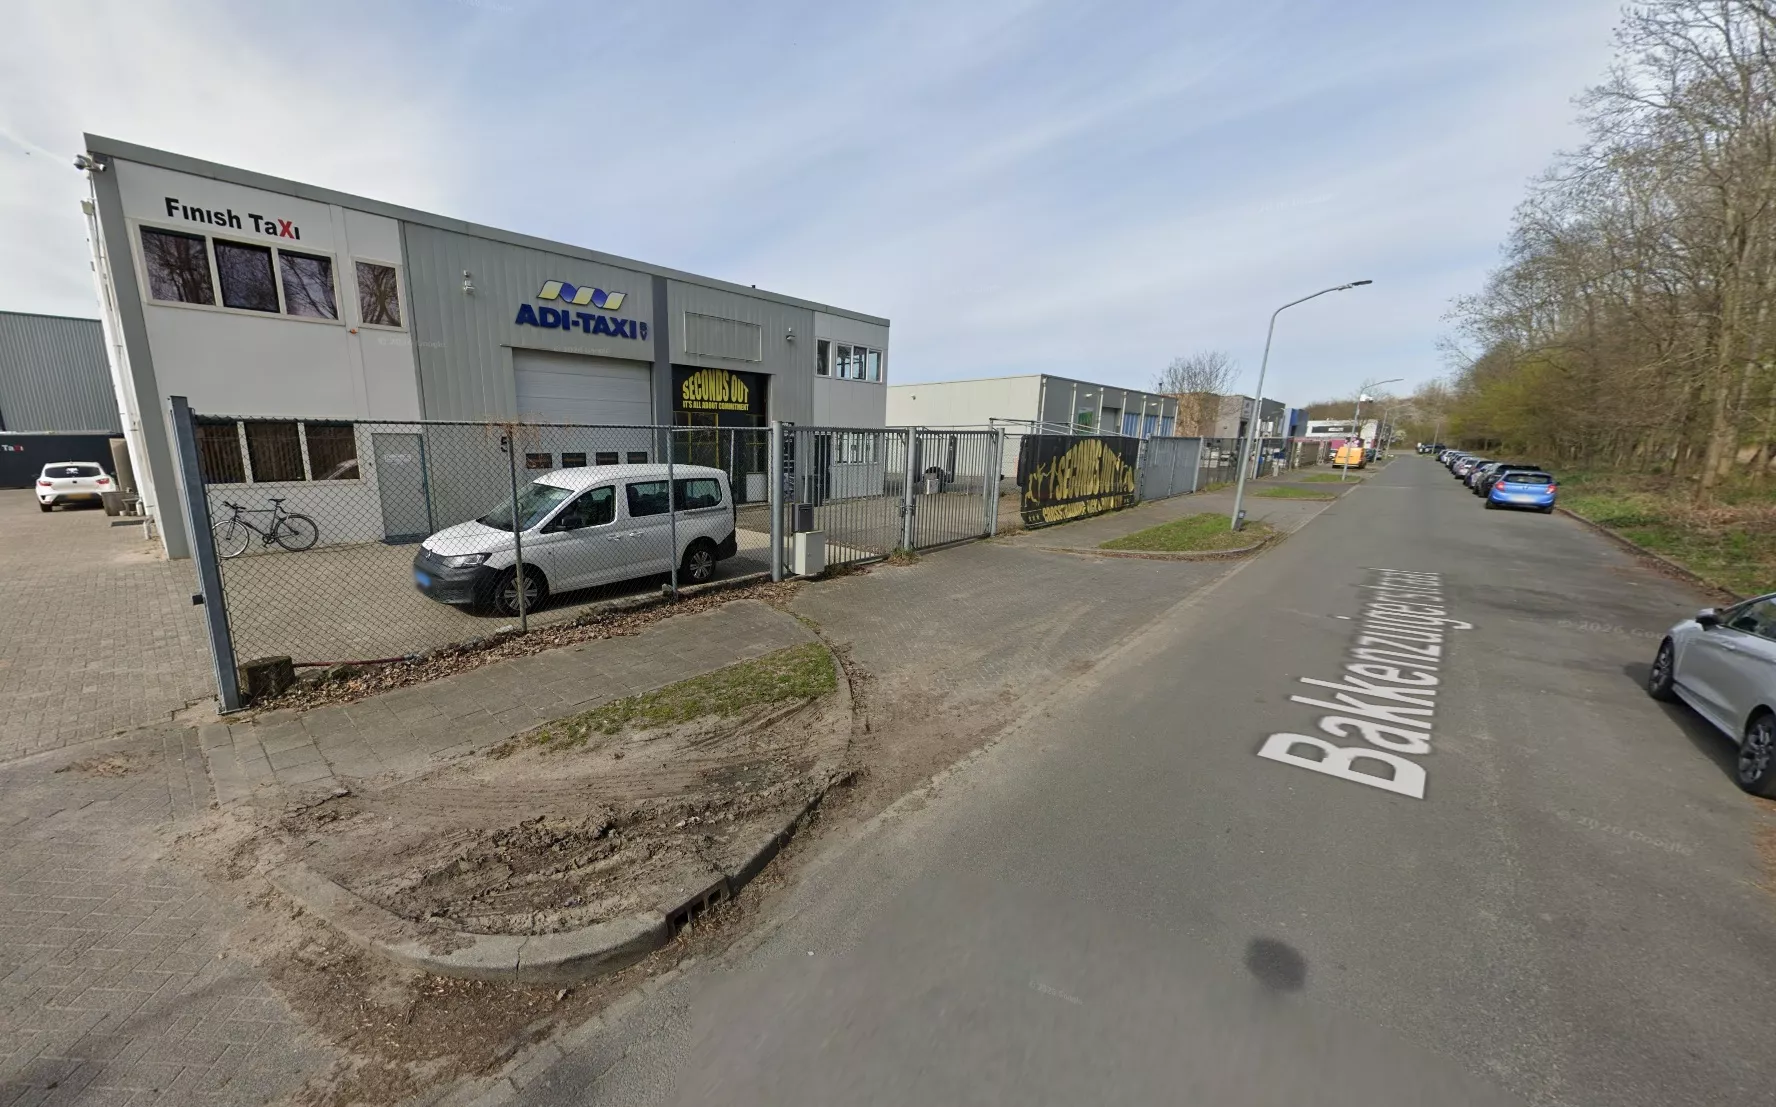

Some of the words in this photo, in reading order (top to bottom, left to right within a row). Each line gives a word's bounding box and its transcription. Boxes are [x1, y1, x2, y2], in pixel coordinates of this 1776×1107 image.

[515, 303, 637, 340] ADI-TAXI
[682, 368, 730, 402] SECONDS
[730, 374, 749, 403] OUT
[693, 401, 702, 409] ALL
[702, 401, 718, 410] ABOUT
[719, 402, 749, 411] COMMITMENT
